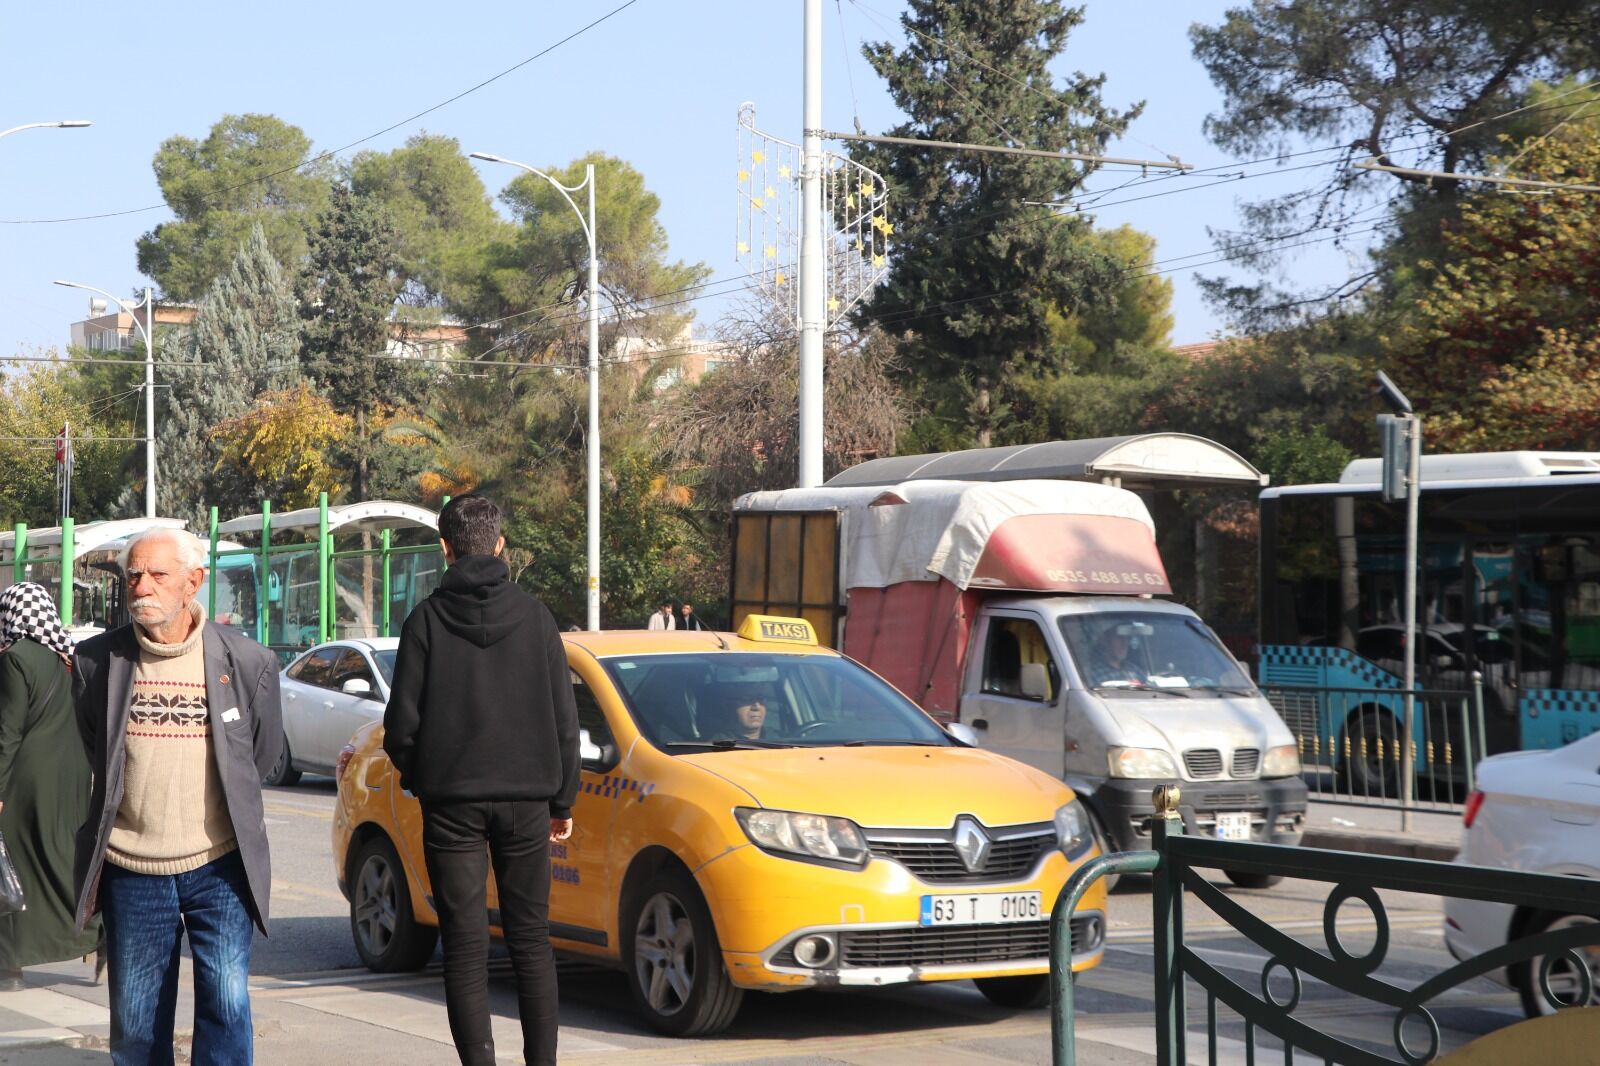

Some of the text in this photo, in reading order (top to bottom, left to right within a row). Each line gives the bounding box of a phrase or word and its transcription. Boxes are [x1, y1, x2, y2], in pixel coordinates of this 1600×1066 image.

[1047, 569, 1087, 583] 0535
[1144, 574, 1165, 586] 63
[934, 899, 955, 921] 63
[969, 898, 978, 920] T
[1001, 896, 1038, 918] 0106
